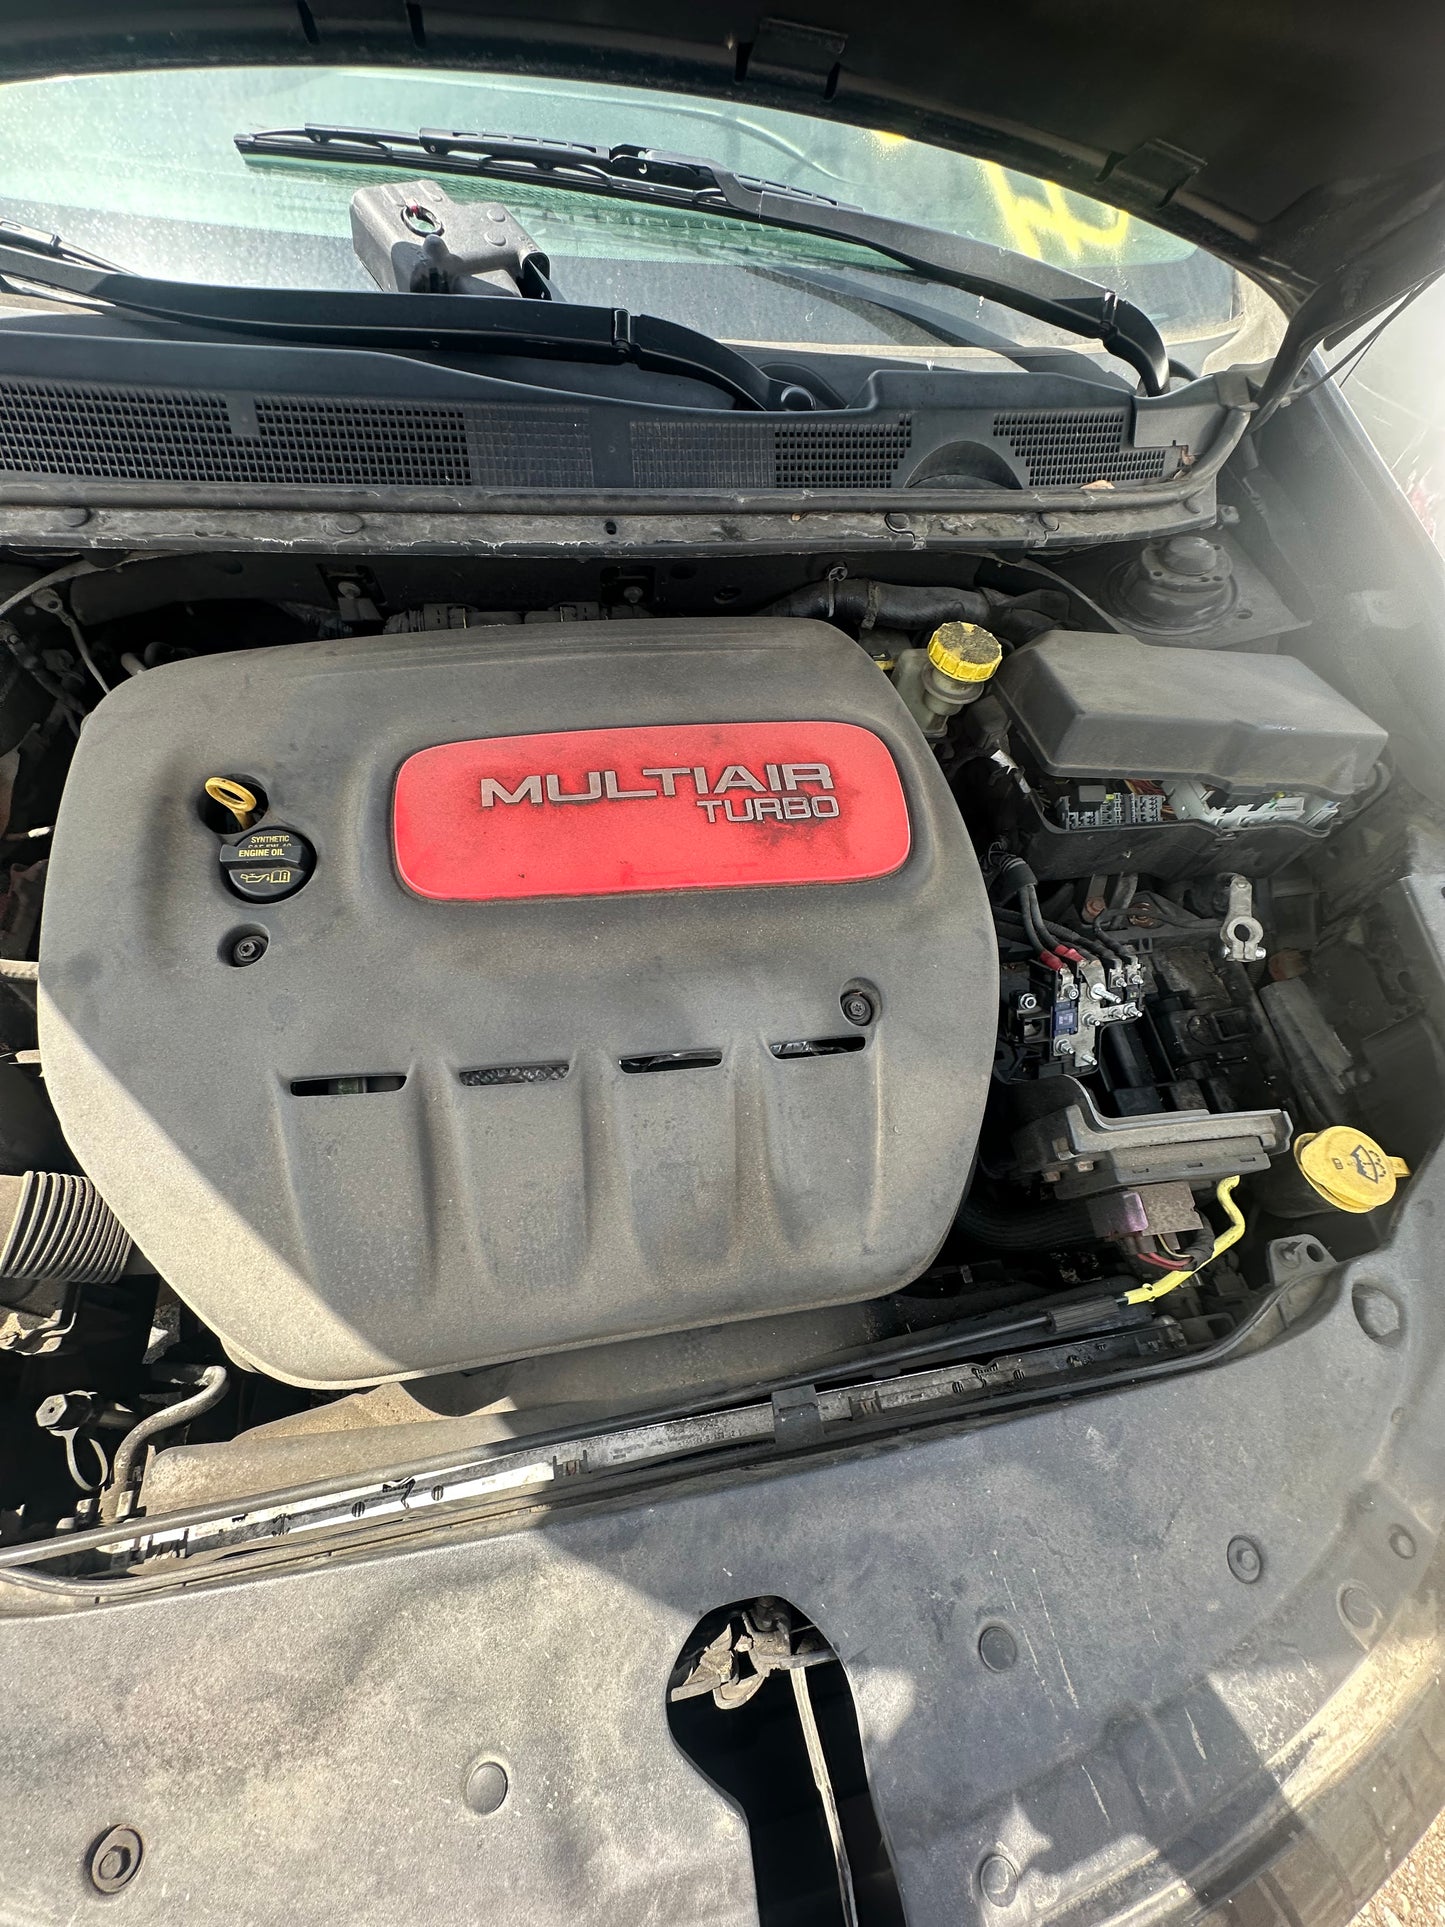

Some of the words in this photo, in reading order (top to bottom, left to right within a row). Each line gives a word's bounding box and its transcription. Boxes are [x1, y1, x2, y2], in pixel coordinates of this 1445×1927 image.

[481, 763, 834, 807] MULTIAIR
[696, 795, 840, 823] TURBO
[250, 835, 290, 843] SYNTHETIC
[238, 848, 270, 857] ENGINE
[271, 848, 285, 856] OIL
